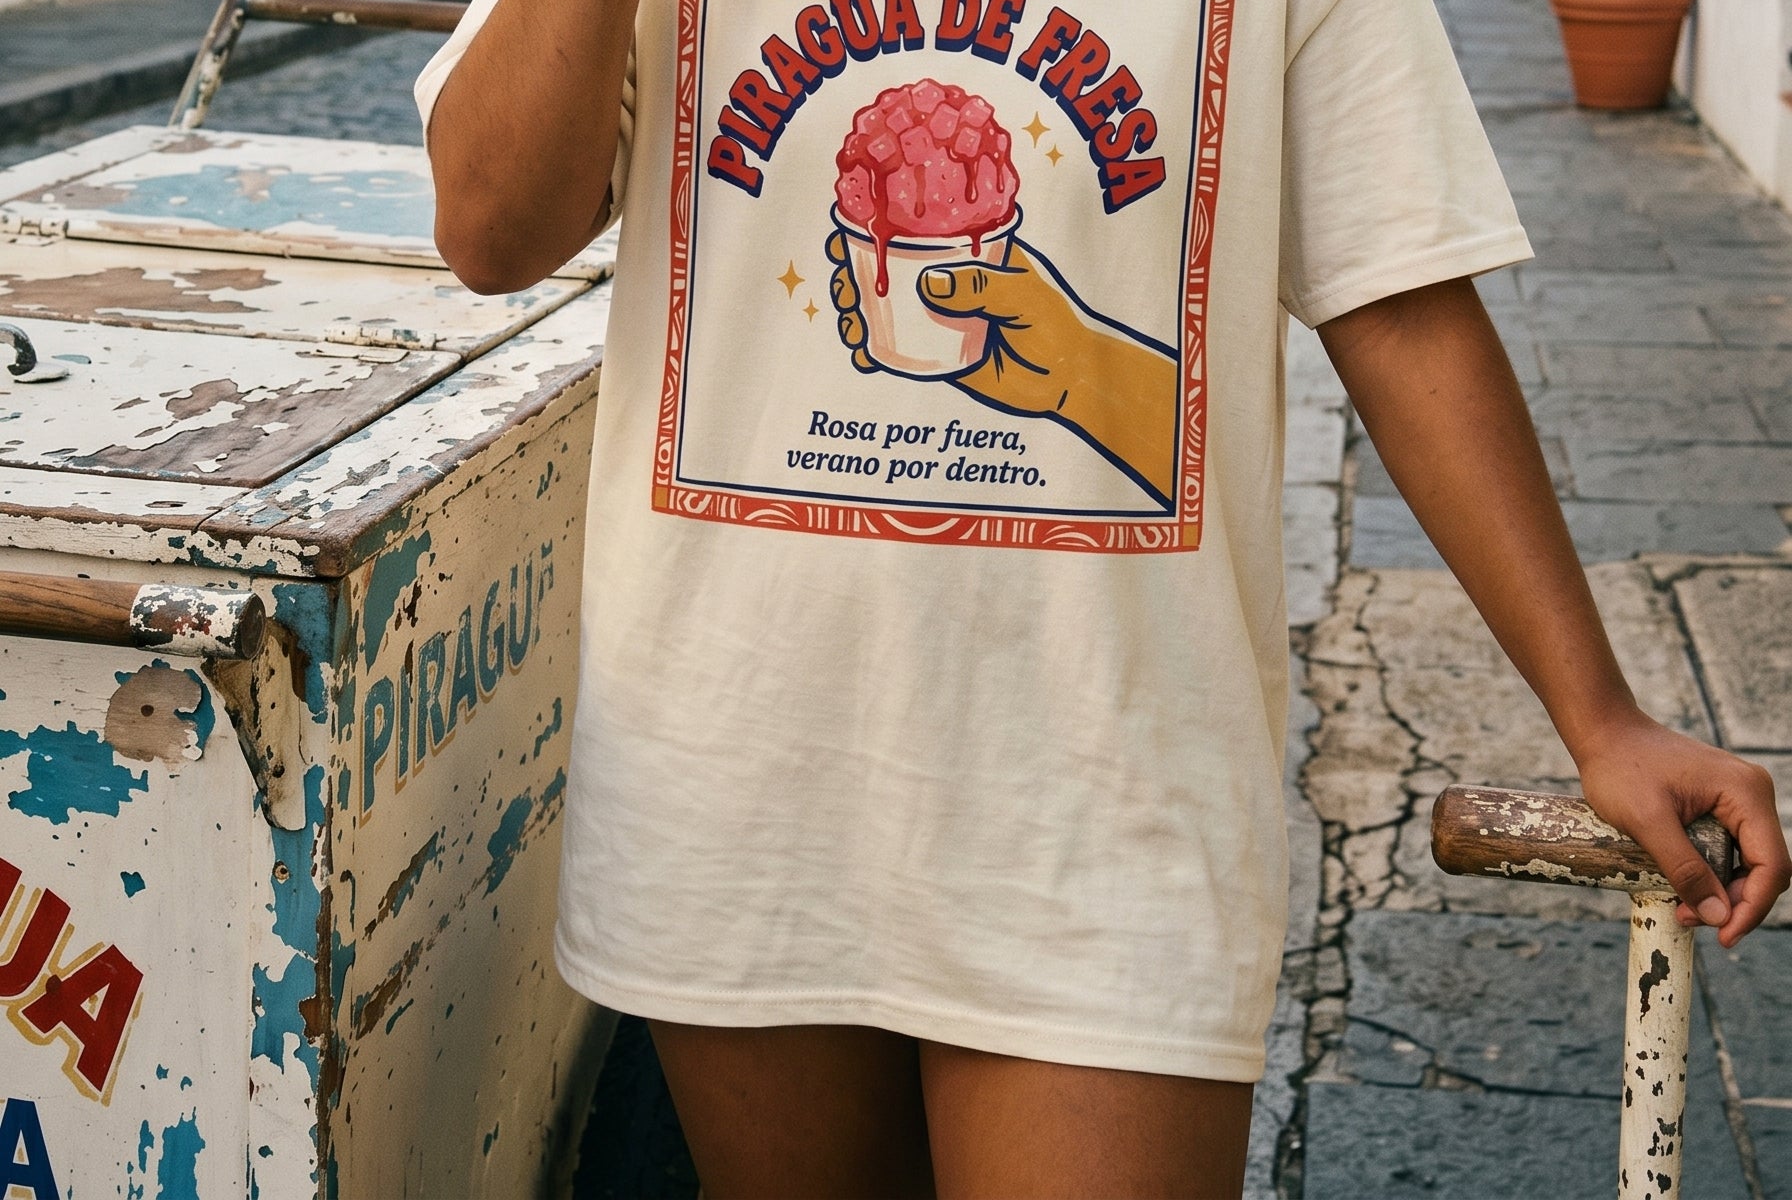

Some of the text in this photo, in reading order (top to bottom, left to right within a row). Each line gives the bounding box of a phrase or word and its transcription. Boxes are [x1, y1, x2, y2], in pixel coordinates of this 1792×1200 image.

[1015, 6, 1166, 215] FRESA
[808, 410, 1027, 455] Rosa por fuera,
[786, 449, 1047, 487] verano por dentro.
